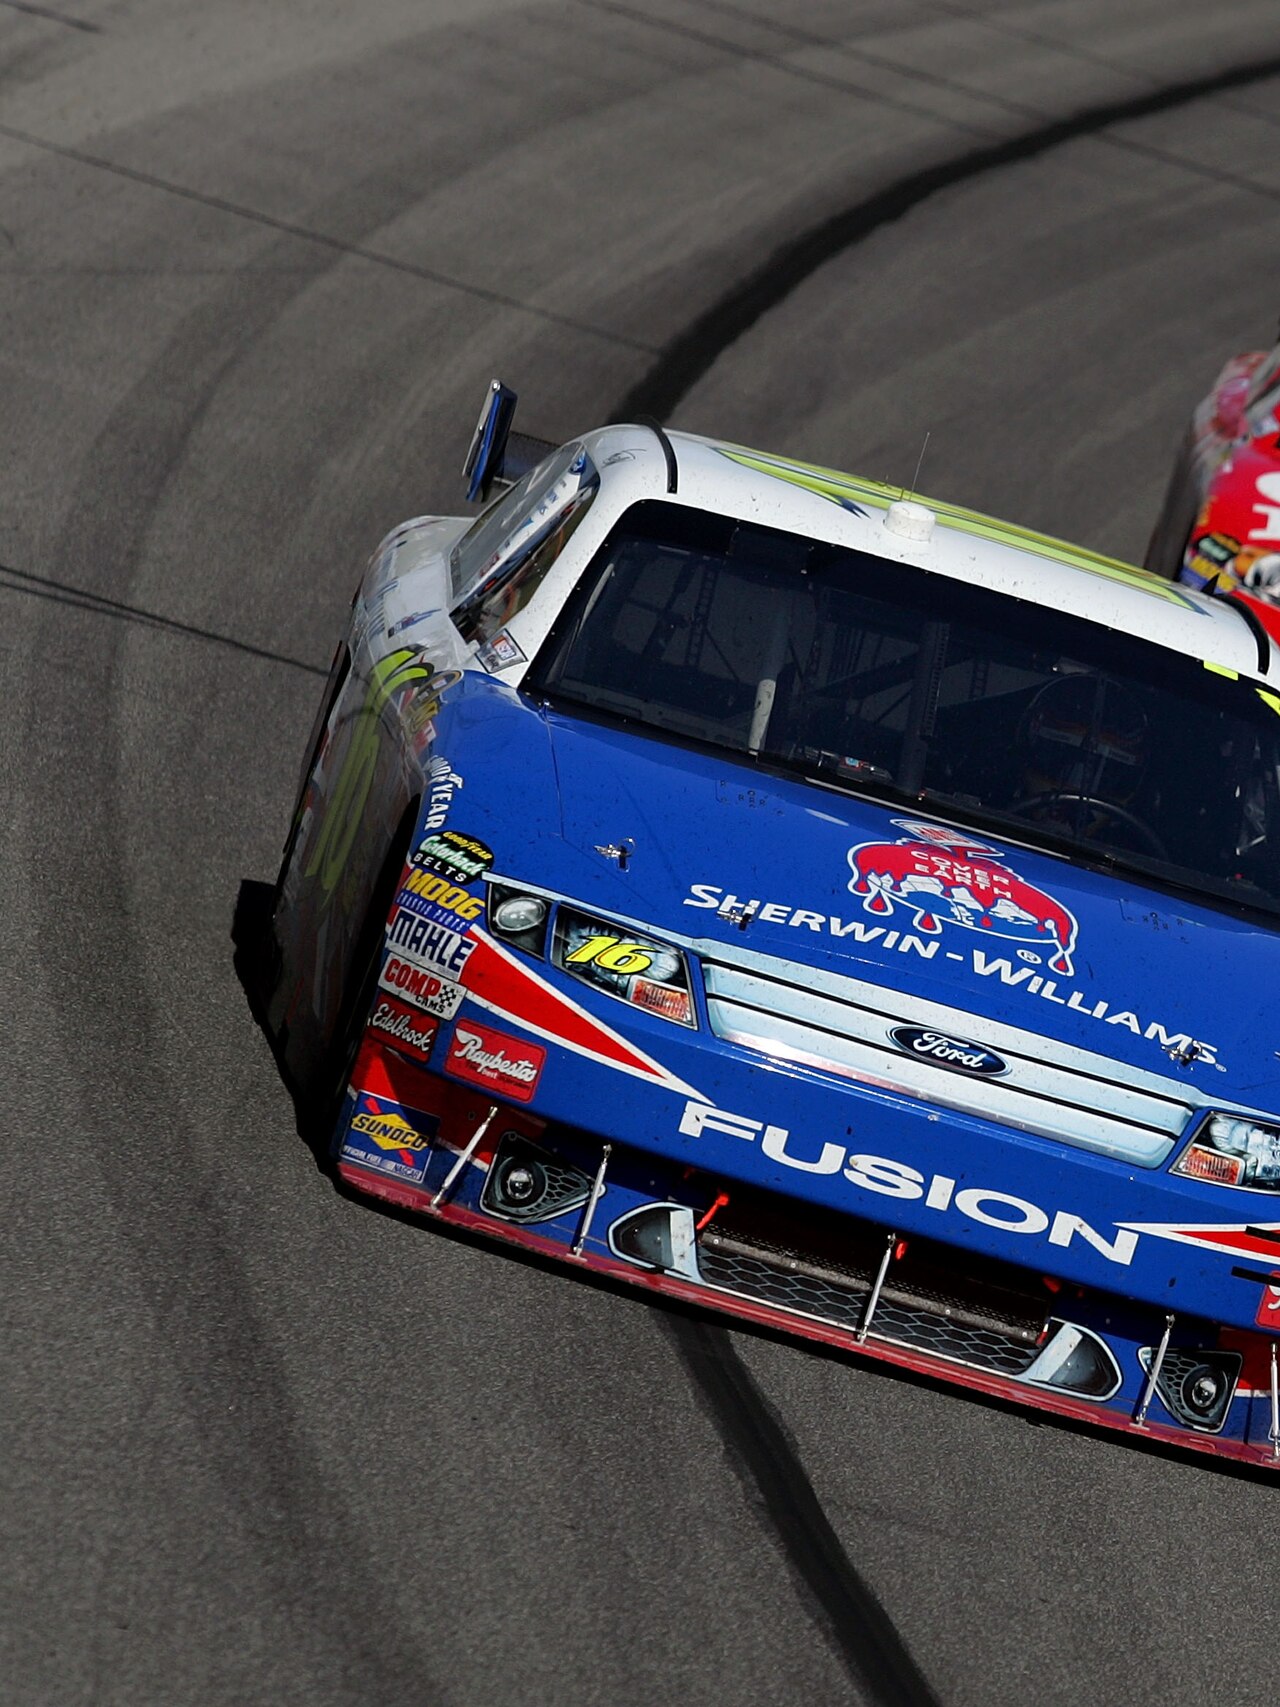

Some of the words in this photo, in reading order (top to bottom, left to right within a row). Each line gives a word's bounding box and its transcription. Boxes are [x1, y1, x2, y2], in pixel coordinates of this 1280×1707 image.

[413, 852, 467, 882] BELTS
[910, 850, 1010, 886] COVER
[914, 863, 1013, 899] EARTH
[933, 862, 992, 891] THE
[403, 868, 487, 921] MOOG
[389, 908, 475, 973] MAHLE
[432, 909, 466, 932] PARTS
[565, 934, 654, 974] 16
[383, 958, 443, 998] COMP
[681, 883, 1219, 1067] SHERWIN-WILLIAMS
[415, 995, 447, 1015] CAMS
[373, 1003, 435, 1052] Edelbrock
[453, 1027, 538, 1083] Raybestos
[910, 1031, 986, 1071] Ford
[355, 1115, 428, 1150] SUNOCO
[677, 1100, 1140, 1267] FUSION
